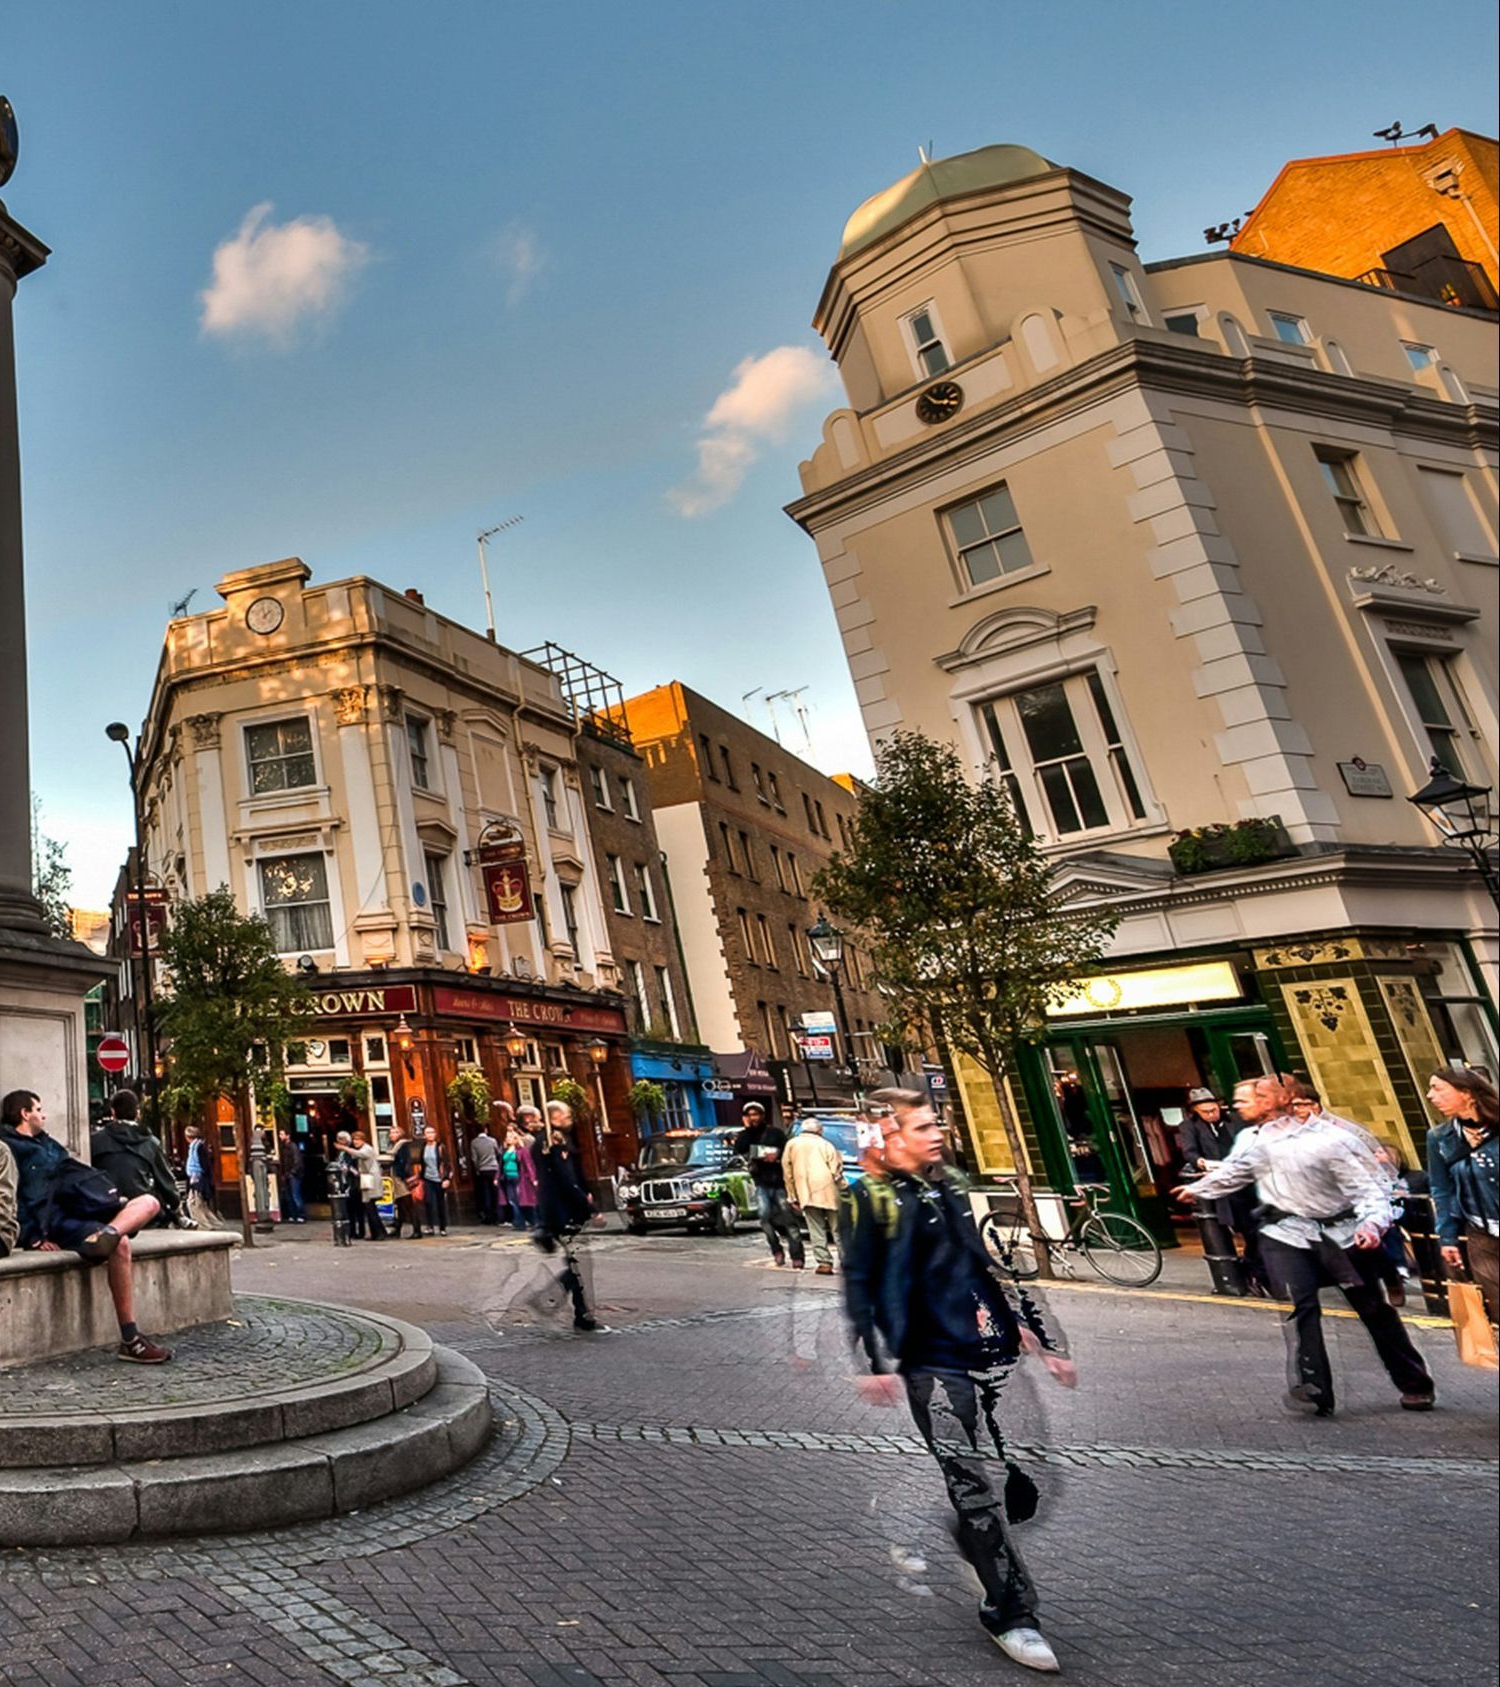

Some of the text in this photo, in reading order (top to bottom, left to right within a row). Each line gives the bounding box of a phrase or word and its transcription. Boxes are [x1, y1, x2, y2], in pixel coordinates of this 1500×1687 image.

[233, 990, 386, 1018] TE CROWN
[507, 1000, 530, 1019] THE
